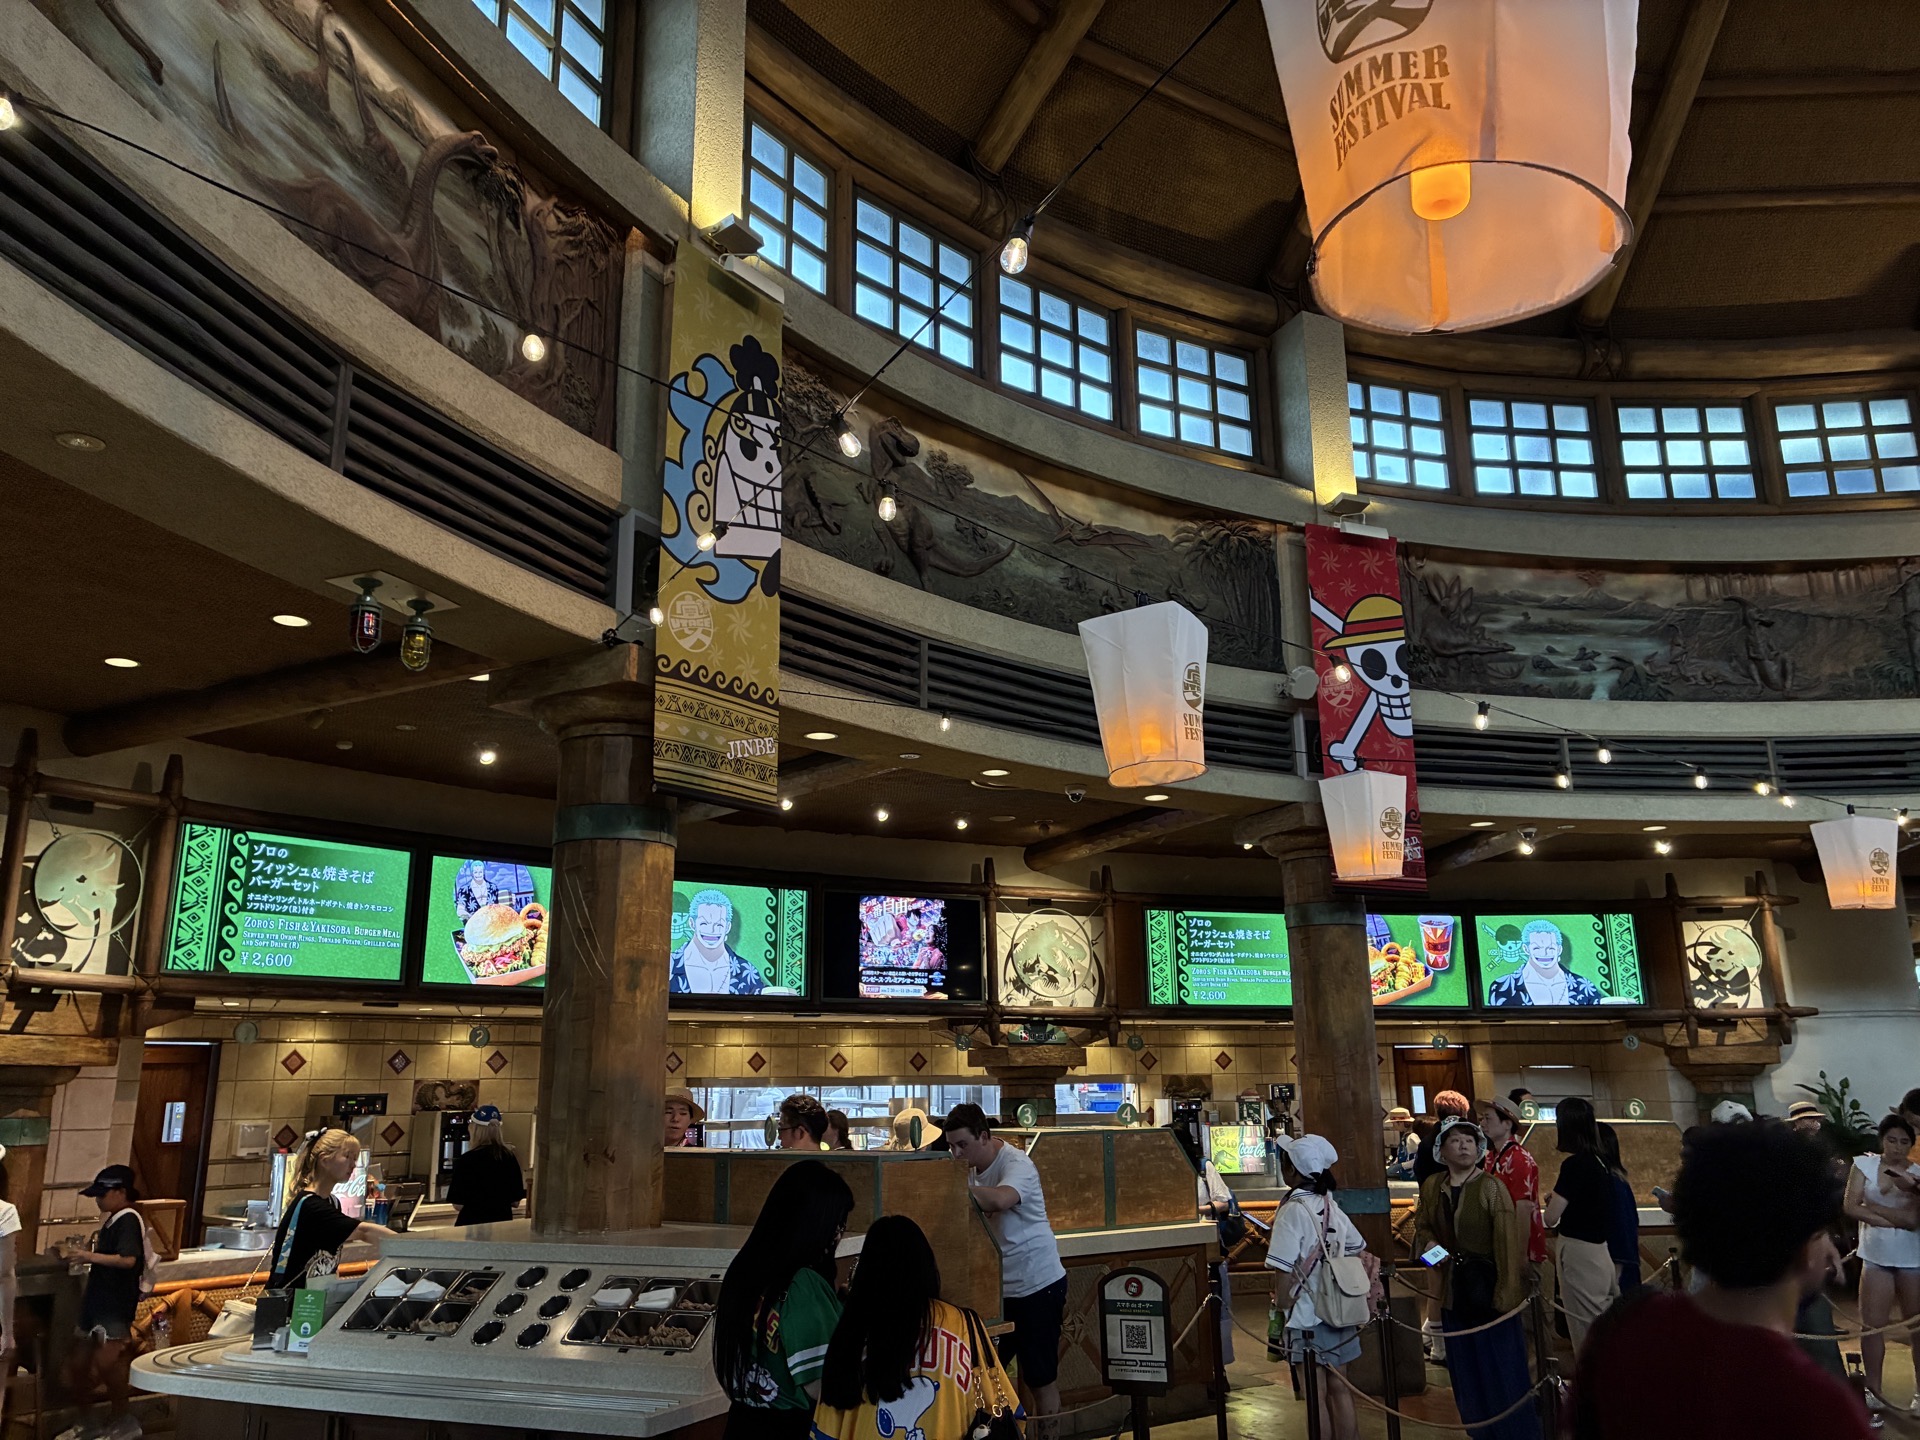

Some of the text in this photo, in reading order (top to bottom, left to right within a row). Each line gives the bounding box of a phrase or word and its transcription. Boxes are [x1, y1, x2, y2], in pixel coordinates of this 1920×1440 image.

[1330, 45, 1450, 134] SUMMER
[1334, 82, 1451, 171] FESTIVAL
[726, 736, 776, 760] JINBE
[252, 843, 289, 859] ゾロの
[251, 859, 375, 885] フィッシュ&焼きそば
[248, 876, 320, 893] バーガーセット
[1189, 918, 1212, 927] ゾロの
[354, 926, 381, 938] BURGER
[382, 928, 401, 940] MEAL
[1189, 929, 1271, 940] フィッシュ&焼きそば
[1190, 940, 1235, 949] バーガーセット
[1121, 1106, 1132, 1122] 4
[1524, 1103, 1534, 1117] 5
[1630, 1101, 1640, 1116] 6
[1023, 1109, 1032, 1124] 3
[1211, 1128, 1224, 1139] ICE
[1214, 1138, 1238, 1149] COLD
[1238, 1142, 1266, 1159] Coca-Co
[911, 1326, 972, 1395] UTS
